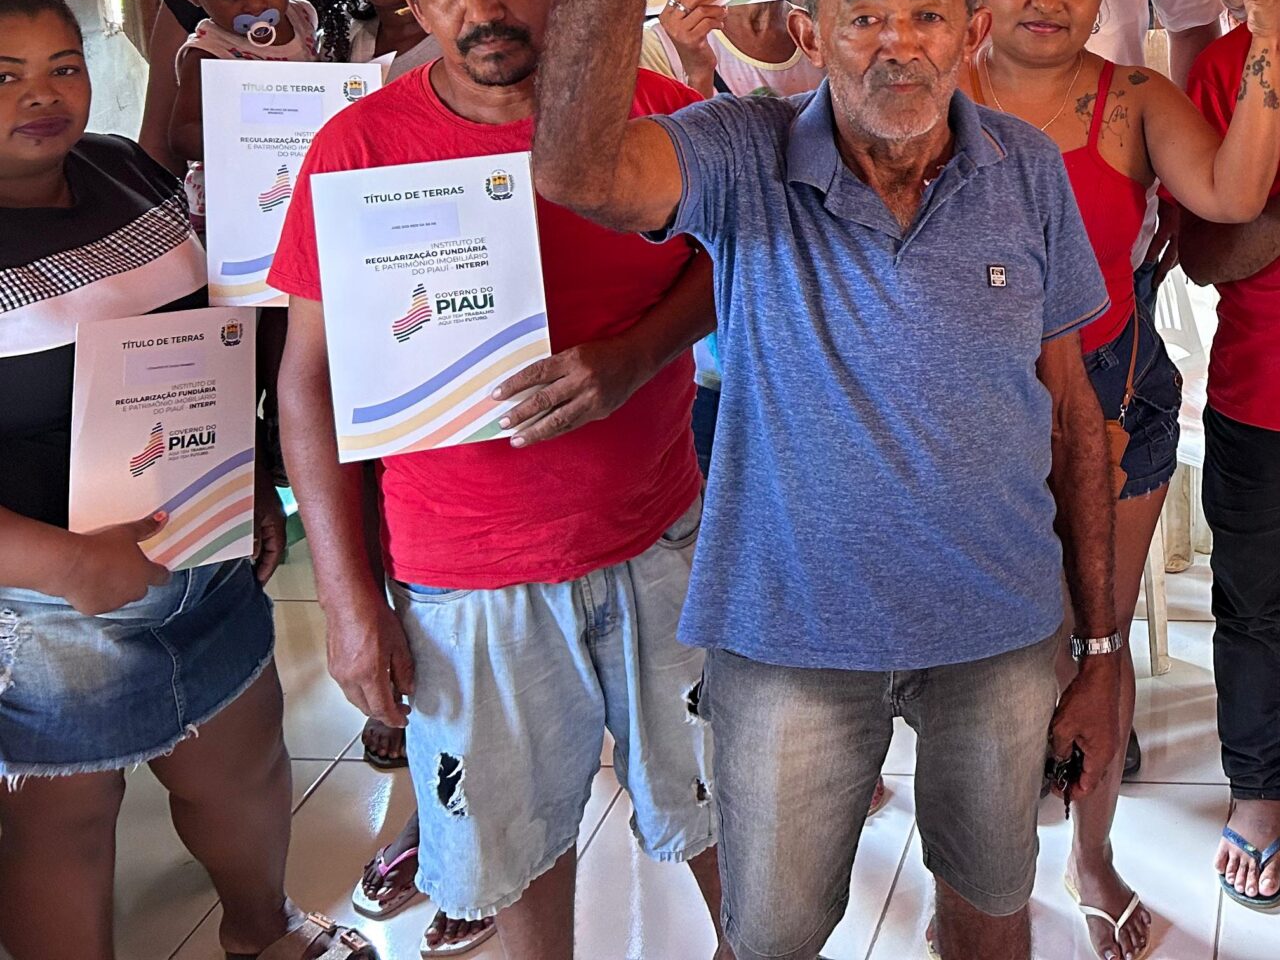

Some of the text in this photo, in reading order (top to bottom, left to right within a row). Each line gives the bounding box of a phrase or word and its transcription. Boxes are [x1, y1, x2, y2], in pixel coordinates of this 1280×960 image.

[243, 82, 274, 91] TÍTULO
[291, 85, 325, 93] TERRAS
[240, 137, 300, 145] REGULARIZAÇÃO
[364, 187, 464, 204] TÍTULO DE TERRAS
[431, 239, 473, 249] INSTITUTO
[365, 245, 487, 265] REGULARIZAÇÃO FUNDIÁRIA
[382, 259, 435, 271] PATRIMÔNIO
[437, 252, 488, 265] IMOBILIÁRIO
[412, 268, 425, 276] DO
[427, 263, 449, 274] PIAUÍ
[455, 260, 489, 270] INTERPI
[435, 286, 493, 300] GOVERNO DO
[436, 293, 494, 315] PIAUÍ
[122, 339, 154, 349] TÍTULO
[171, 334, 205, 344] TERRAS
[116, 386, 216, 406] REGULARIZAÇÃO FUNDIÁRIA
[189, 400, 216, 410] INTERPI
[169, 426, 204, 437] GOVERNO
[169, 430, 216, 451] PIAUÍ
